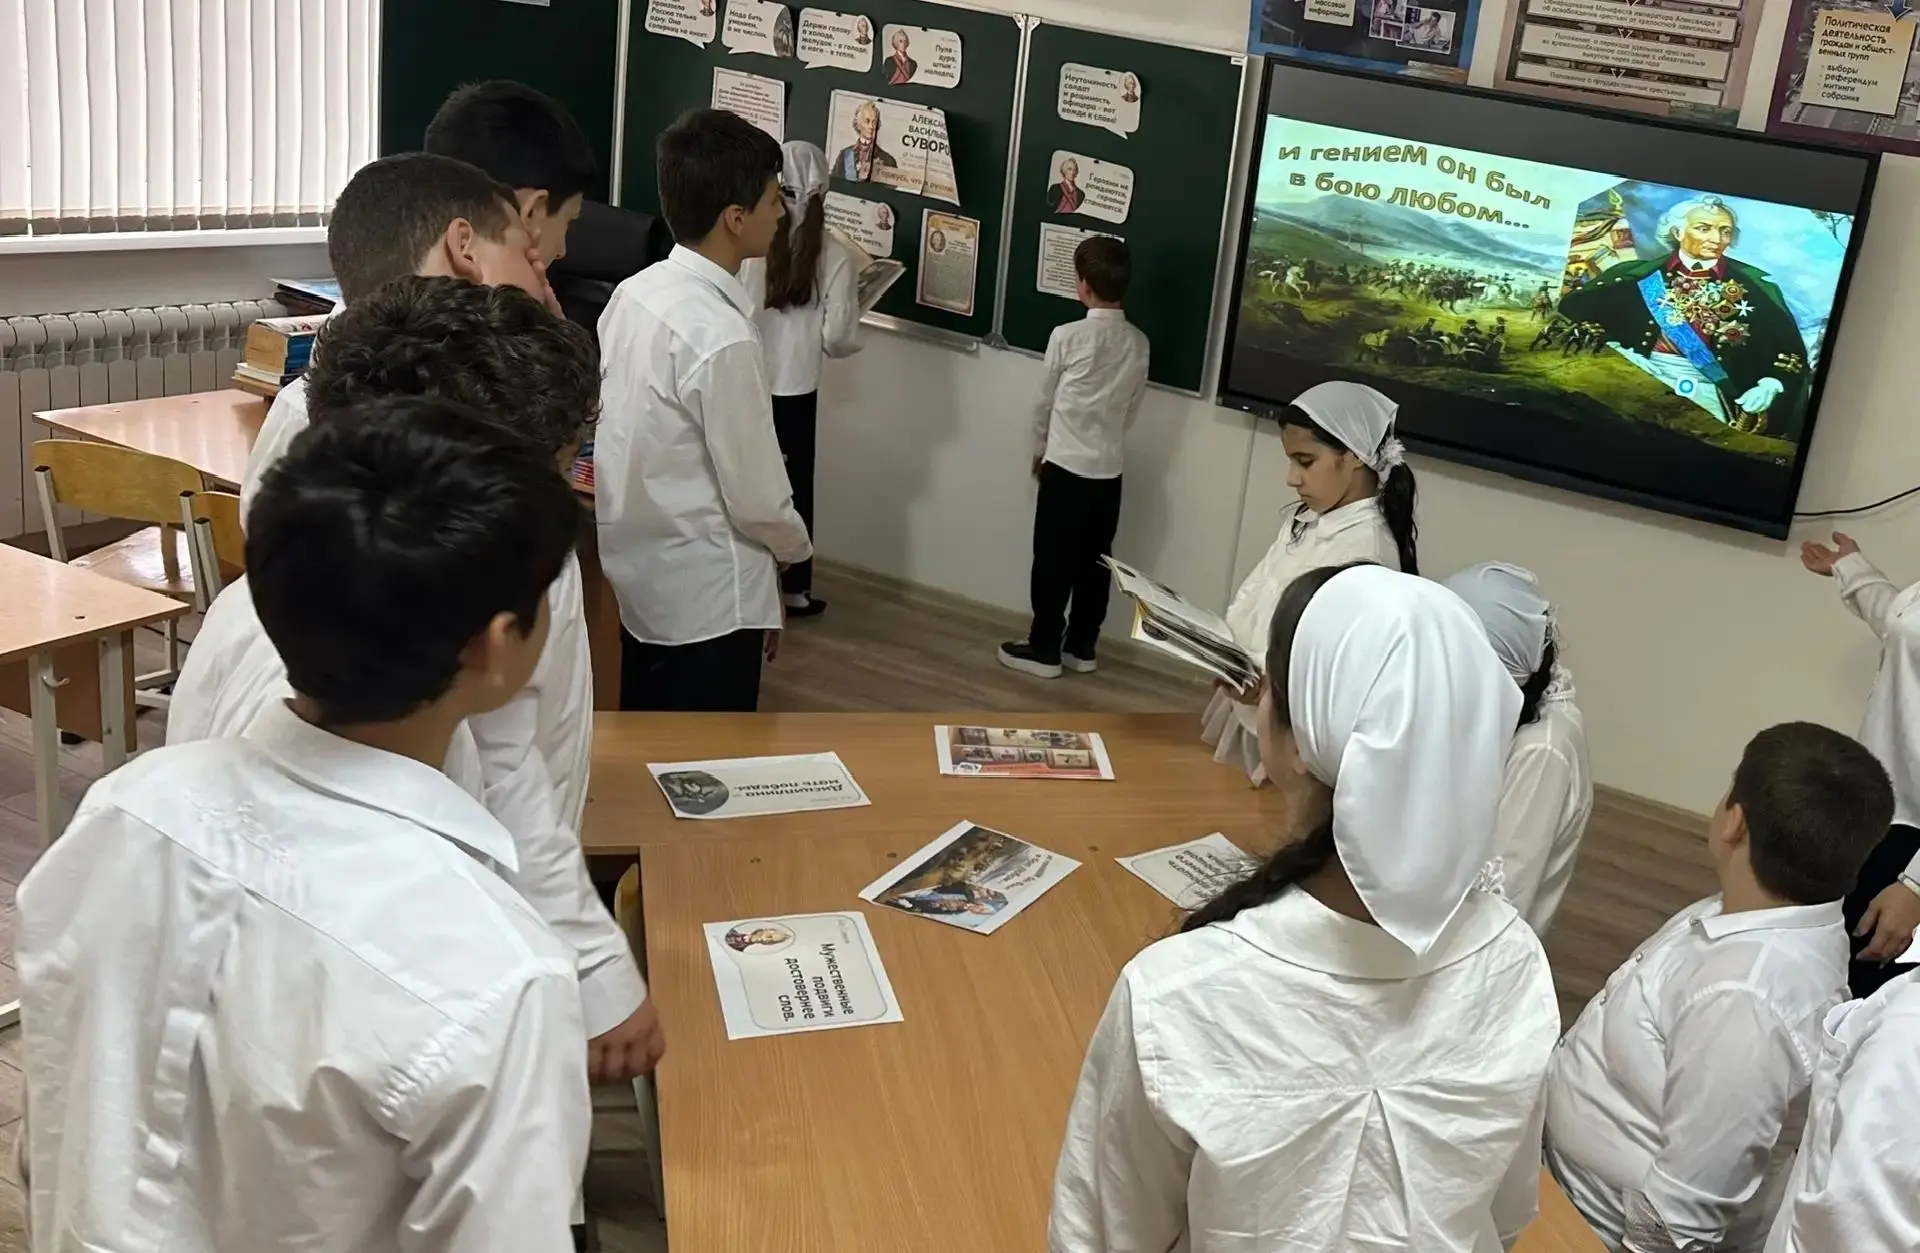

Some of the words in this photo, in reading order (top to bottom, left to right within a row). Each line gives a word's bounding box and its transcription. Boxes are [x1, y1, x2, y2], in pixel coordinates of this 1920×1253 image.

[729, 10, 746, 18] Надо
[748, 13, 762, 21] бить
[1308, 7, 1350, 18] информации
[802, 20, 827, 30] Держи
[828, 24, 851, 35] голову
[1824, 15, 1891, 33] Политическая
[1821, 29, 1887, 44] деятельность
[1818, 48, 1846, 58] венных
[1848, 52, 1870, 61] групп
[1820, 39, 1854, 50] граждан
[1861, 44, 1895, 55] общест-
[1827, 64, 1858, 74] выборы
[1064, 83, 1090, 92] солдат
[1065, 74, 1118, 89] Неутомимость
[1825, 73, 1878, 87] референдум
[1823, 83, 1856, 93] митинги
[1070, 93, 1111, 105] решимость
[1821, 91, 1860, 102] собрания
[1062, 100, 1096, 110] офицера
[1089, 173, 1119, 188] Героями
[1278, 145, 1300, 161] и
[1310, 144, 1428, 166] гением
[1437, 155, 1477, 184] он
[1485, 170, 1551, 209] был
[1289, 172, 1306, 187] в
[1315, 172, 1381, 200] бою
[1387, 186, 1530, 230] любом...
[745, 782, 844, 797] Дисциплина
[802, 779, 840, 788] мать
[820, 943, 854, 1016] Мужественные
[784, 957, 815, 1020] достовернее
[812, 975, 835, 1018] подвиги
[777, 994, 795, 1022] слов.
